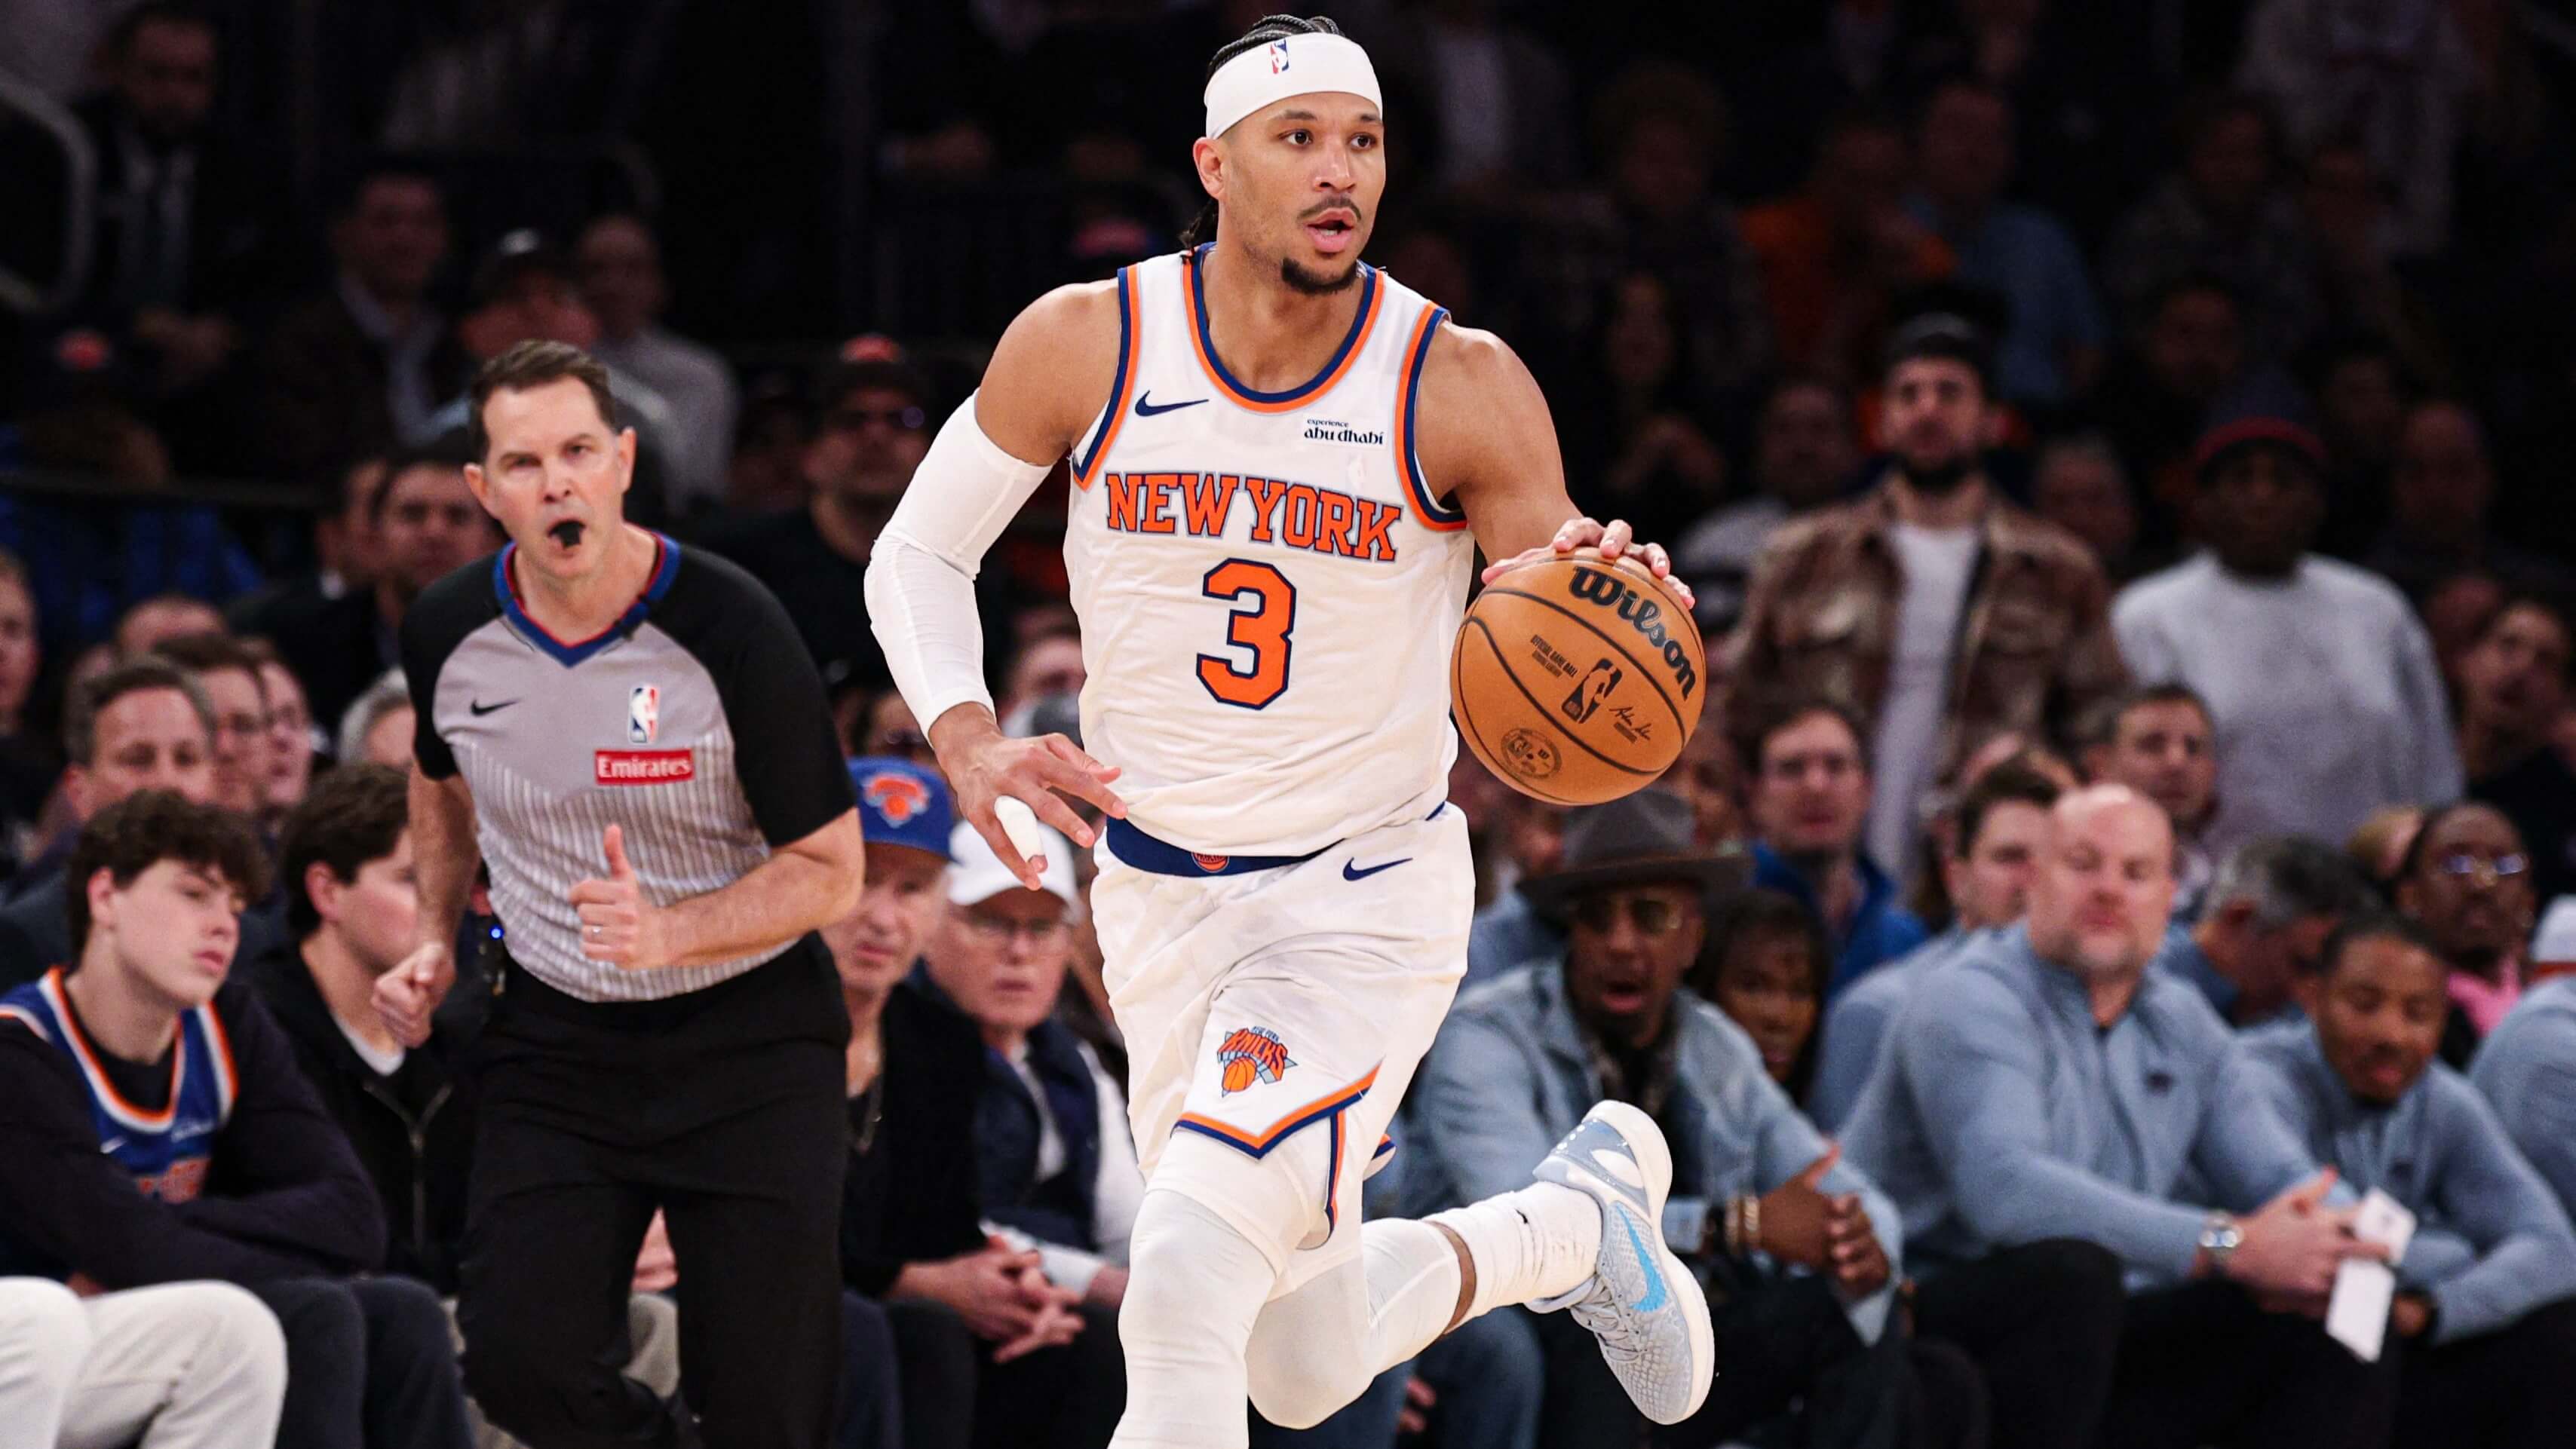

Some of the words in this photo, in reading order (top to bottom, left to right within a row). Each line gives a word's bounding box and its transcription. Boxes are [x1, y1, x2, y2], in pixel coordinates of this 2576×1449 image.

[1304, 427, 1334, 441] abu
[1338, 430, 1385, 445] dhabi
[1307, 418, 1349, 427] experience
[1106, 471, 1238, 537] NEW
[1244, 476, 1404, 563] YORK
[1196, 557, 1297, 711] 3
[1569, 565, 1696, 702] Wilson
[597, 755, 692, 778] Emirates
[1217, 1028, 1288, 1081] KNICKS
